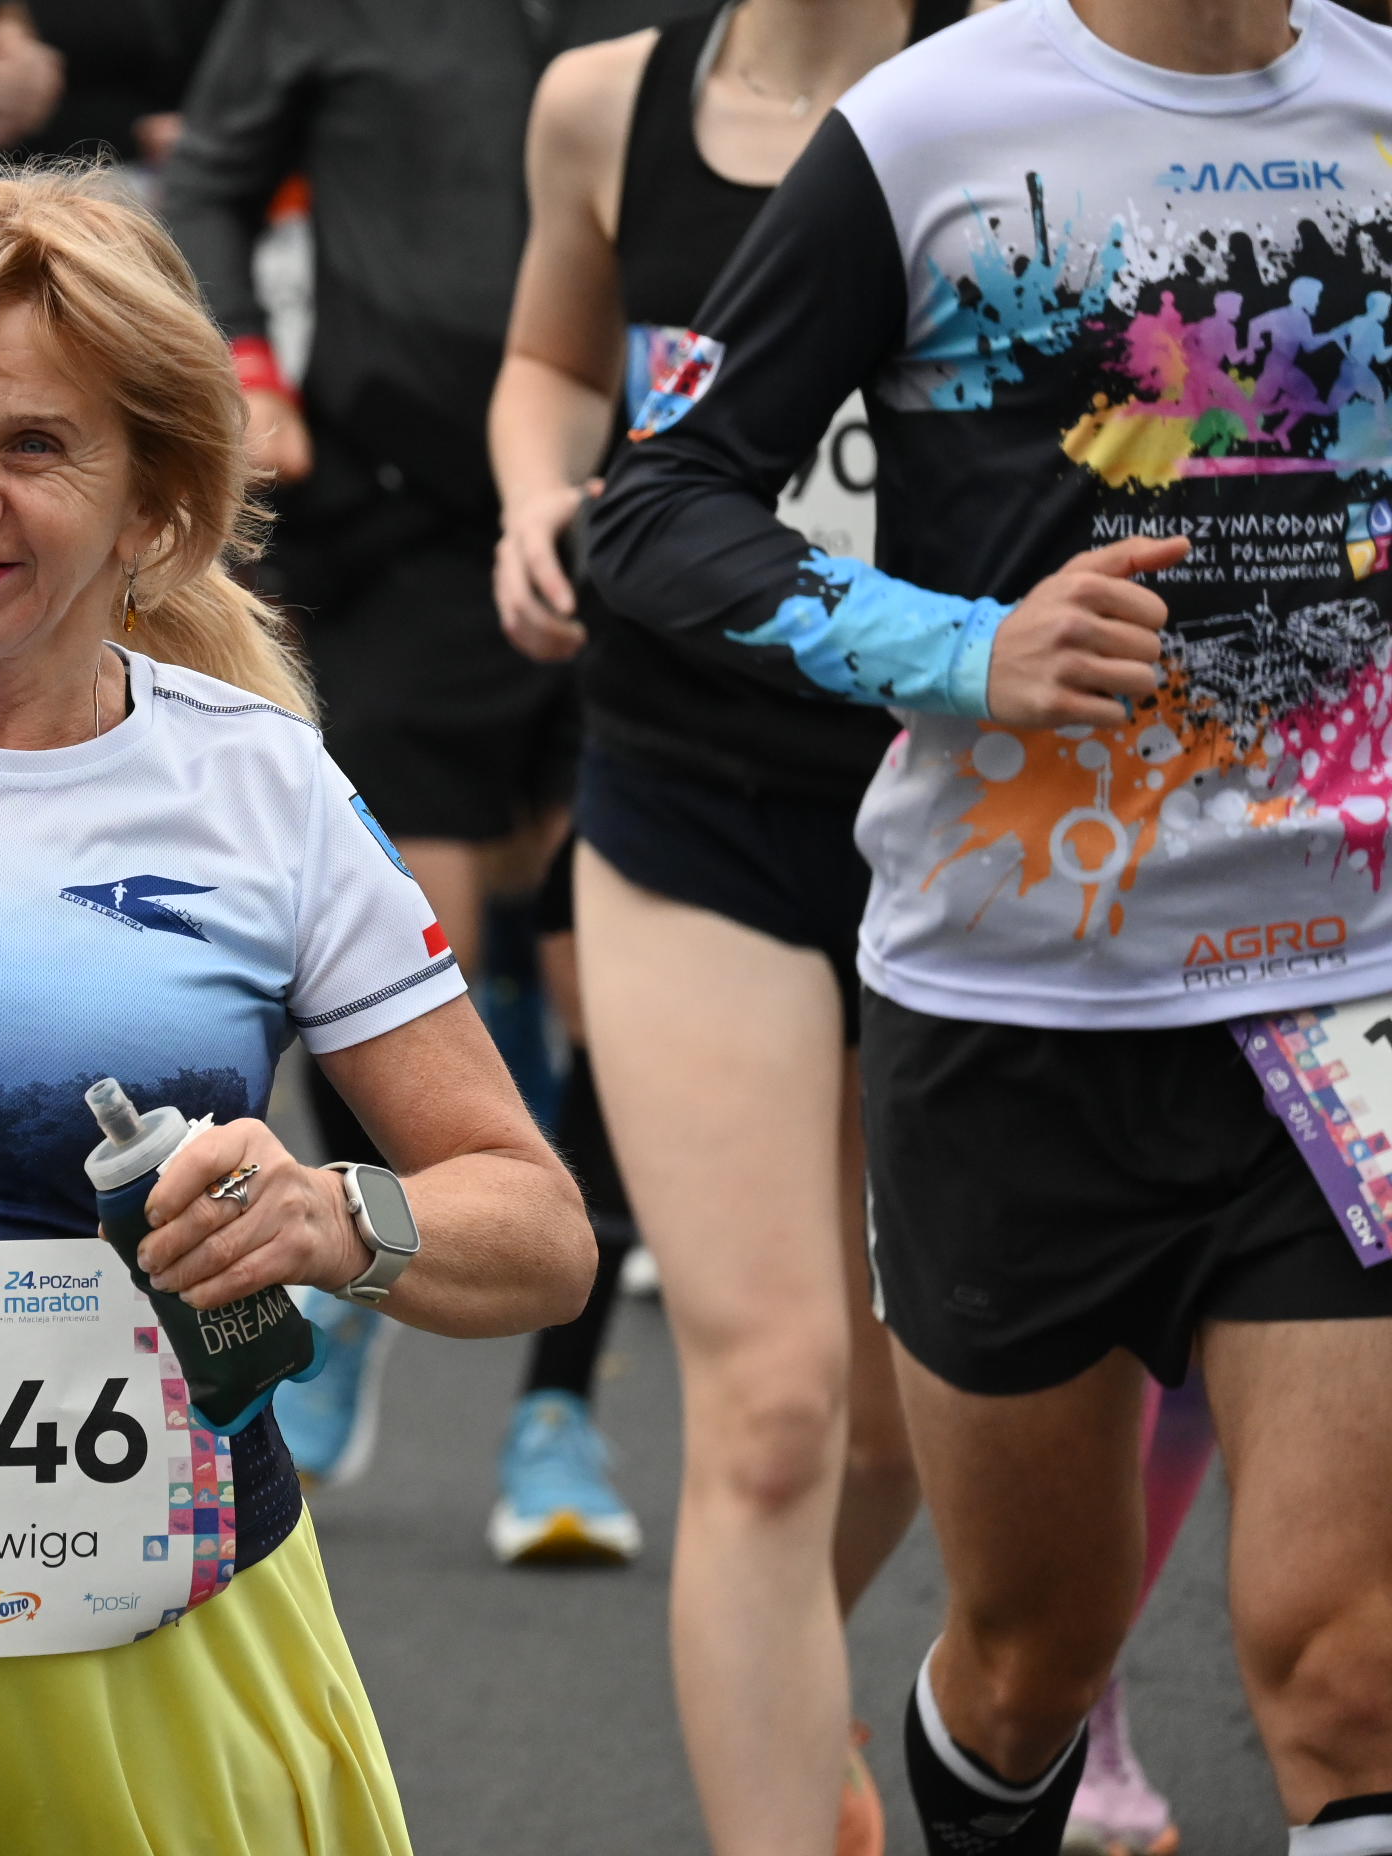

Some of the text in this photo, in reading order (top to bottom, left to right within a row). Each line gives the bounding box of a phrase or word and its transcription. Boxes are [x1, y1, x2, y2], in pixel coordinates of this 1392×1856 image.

[58, 891, 88, 907] KLUB
[90, 904, 144, 933] BIEGACZA
[1183, 915, 1348, 968] AGRO
[4, 1271, 37, 1290] 24.
[4, 1293, 99, 1313] maraton
